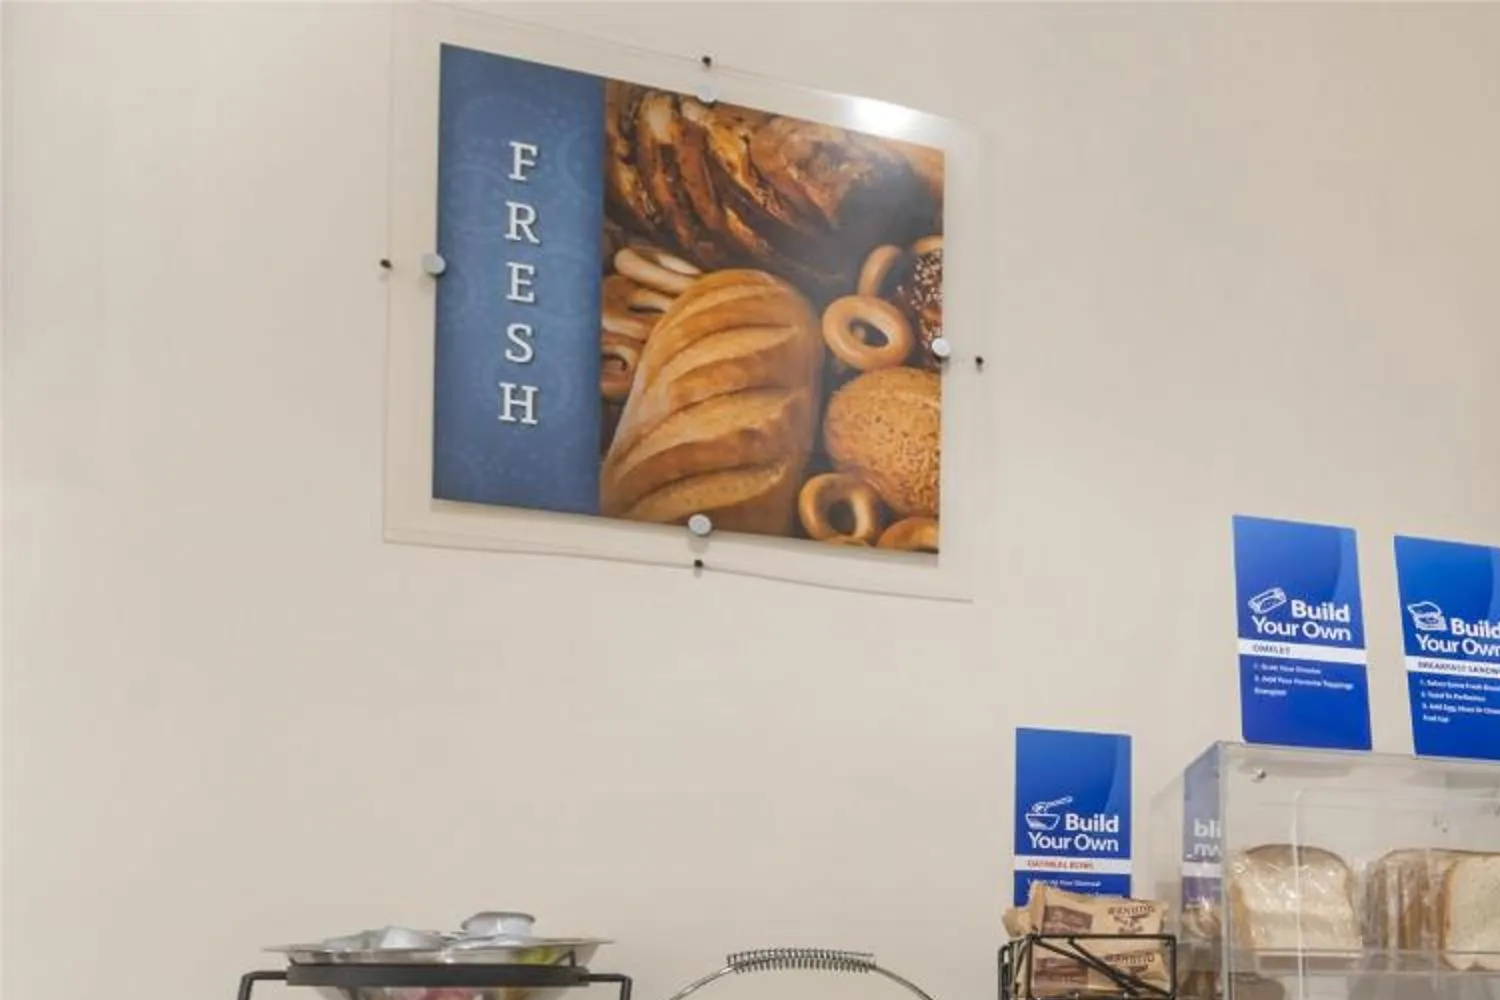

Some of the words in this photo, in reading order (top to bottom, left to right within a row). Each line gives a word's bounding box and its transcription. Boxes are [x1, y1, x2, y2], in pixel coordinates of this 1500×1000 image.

[497, 140, 540, 426] FRESH
[1291, 599, 1351, 623] Build
[1251, 615, 1301, 637] Your
[1302, 621, 1352, 642] Own
[1415, 632, 1458, 655] Your
[1065, 812, 1120, 834] Build
[1028, 831, 1071, 850] Your
[1074, 833, 1119, 853] Own
